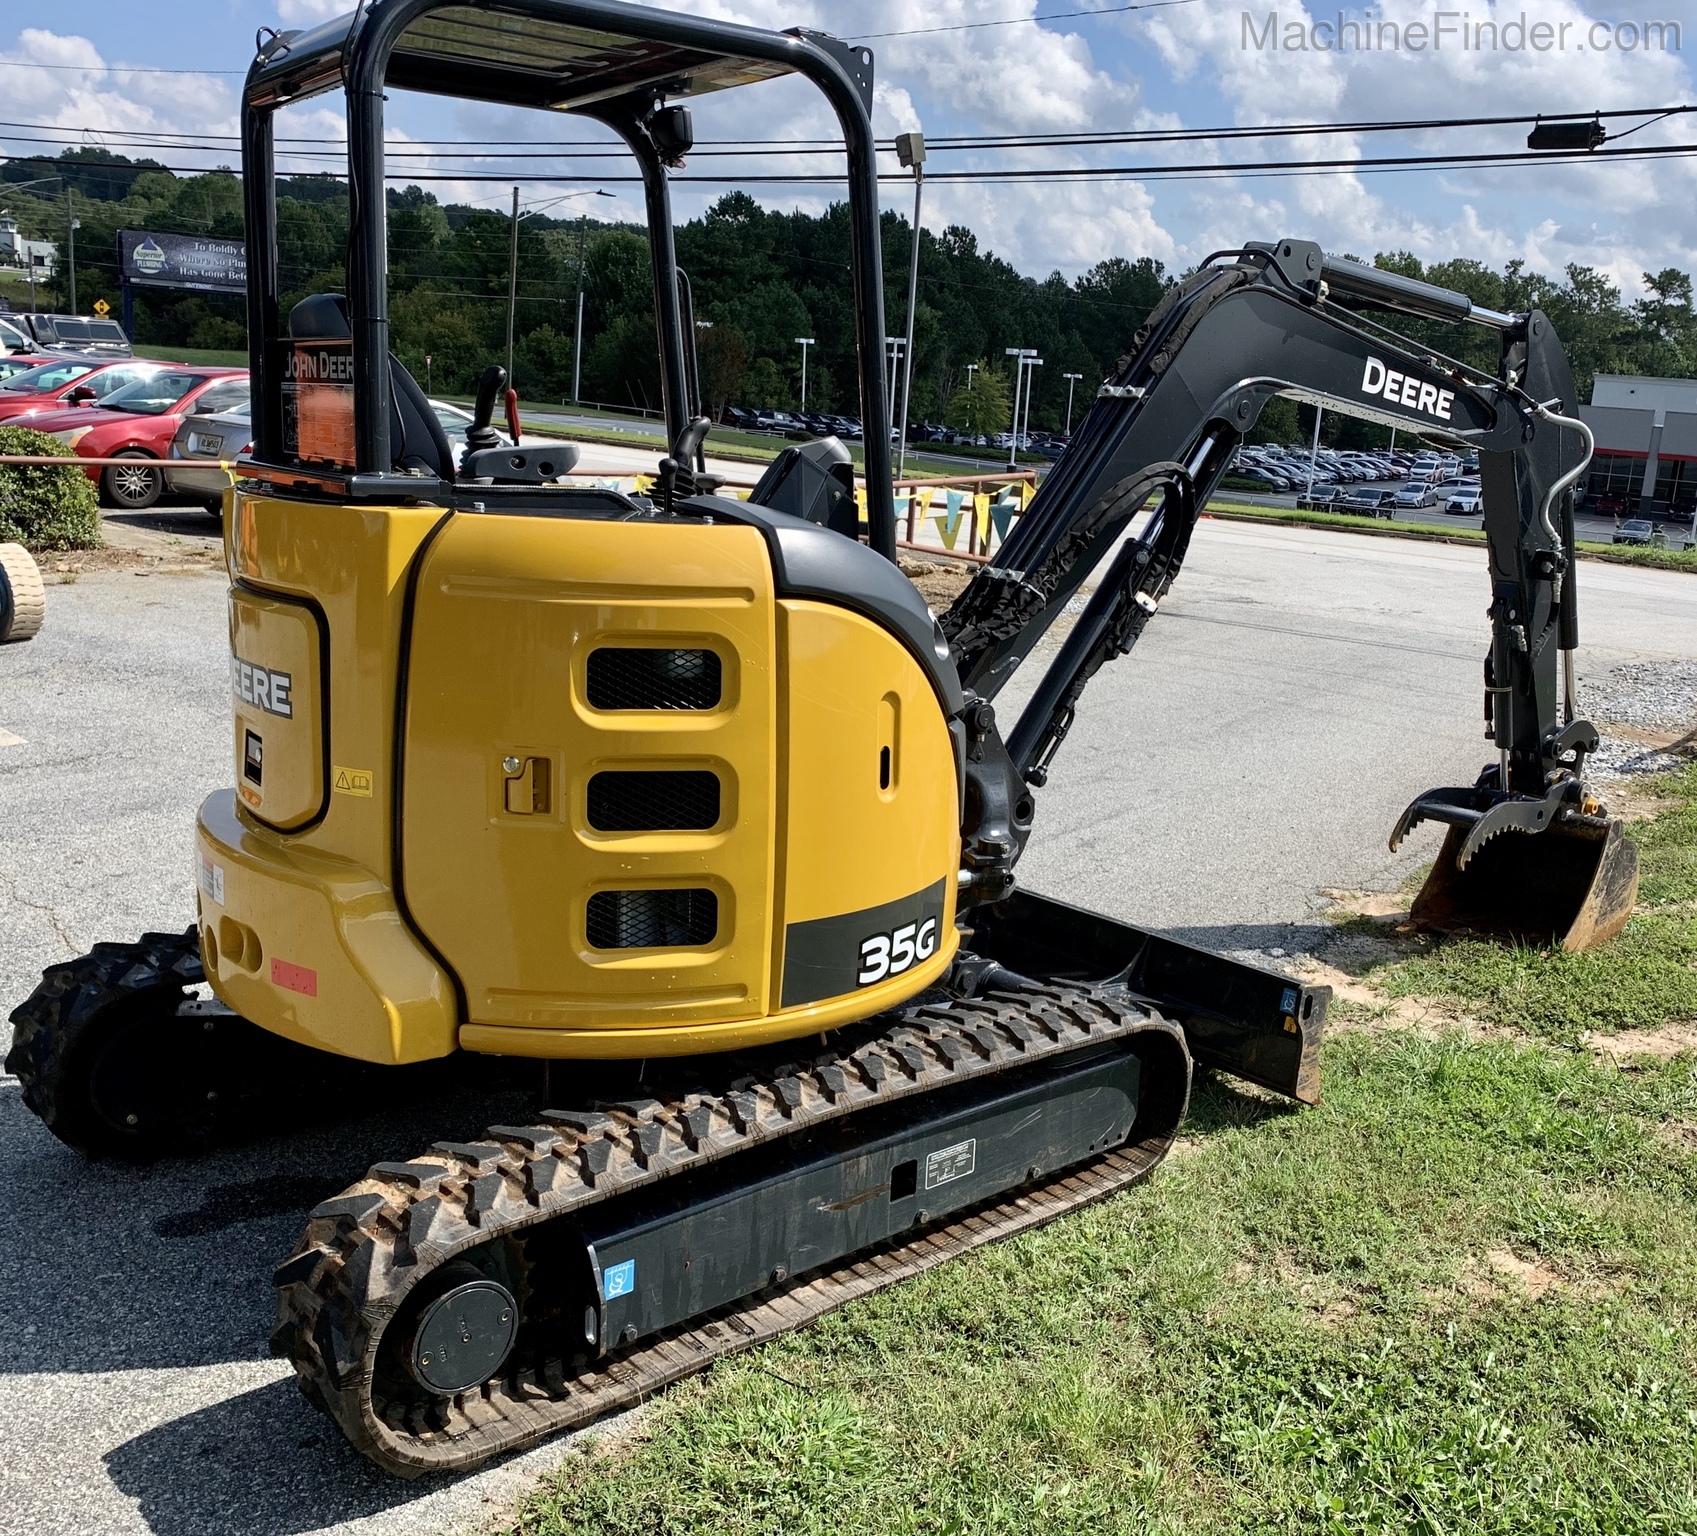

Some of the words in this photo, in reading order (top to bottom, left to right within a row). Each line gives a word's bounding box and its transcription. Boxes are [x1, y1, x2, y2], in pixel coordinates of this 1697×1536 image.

[135, 249, 163, 259] Superior
[194, 242, 206, 251] To
[208, 243, 238, 256] Boldly
[137, 260, 163, 269] PLUMBING
[179, 253, 211, 265] Where
[214, 257, 226, 266] No
[228, 259, 247, 268] Plu
[179, 266, 198, 277] Has
[201, 268, 226, 278] Gone
[285, 351, 317, 379] JOHN
[319, 351, 354, 379] DEER
[1361, 355, 1455, 421] DEERE
[231, 656, 291, 717] EERE
[858, 917, 936, 985] 35G
